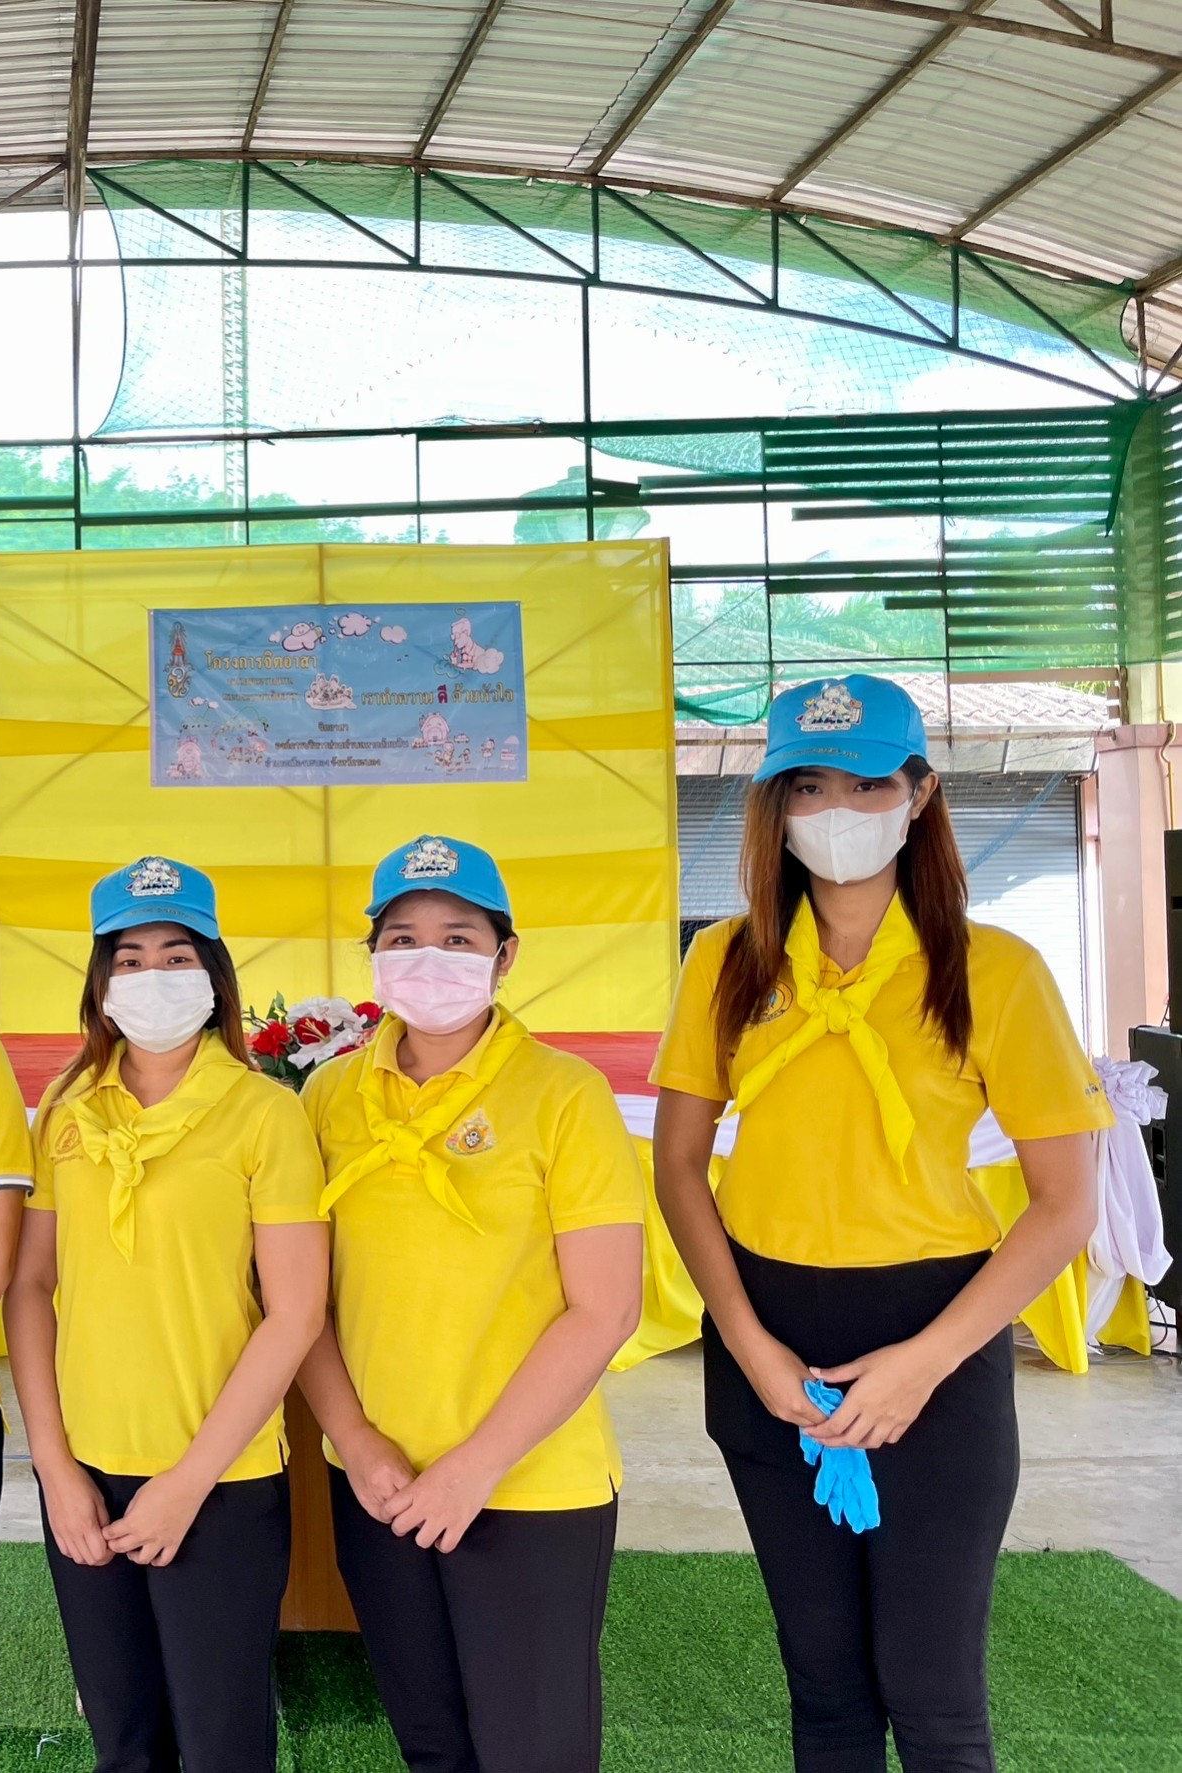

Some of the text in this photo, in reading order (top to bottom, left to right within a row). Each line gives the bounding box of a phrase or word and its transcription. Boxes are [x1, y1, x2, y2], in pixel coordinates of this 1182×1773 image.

[205, 649, 318, 670] โครงการจิตอาสา
[360, 681, 515, 706] เราทำความ ดี ด้วยหัวใจ
